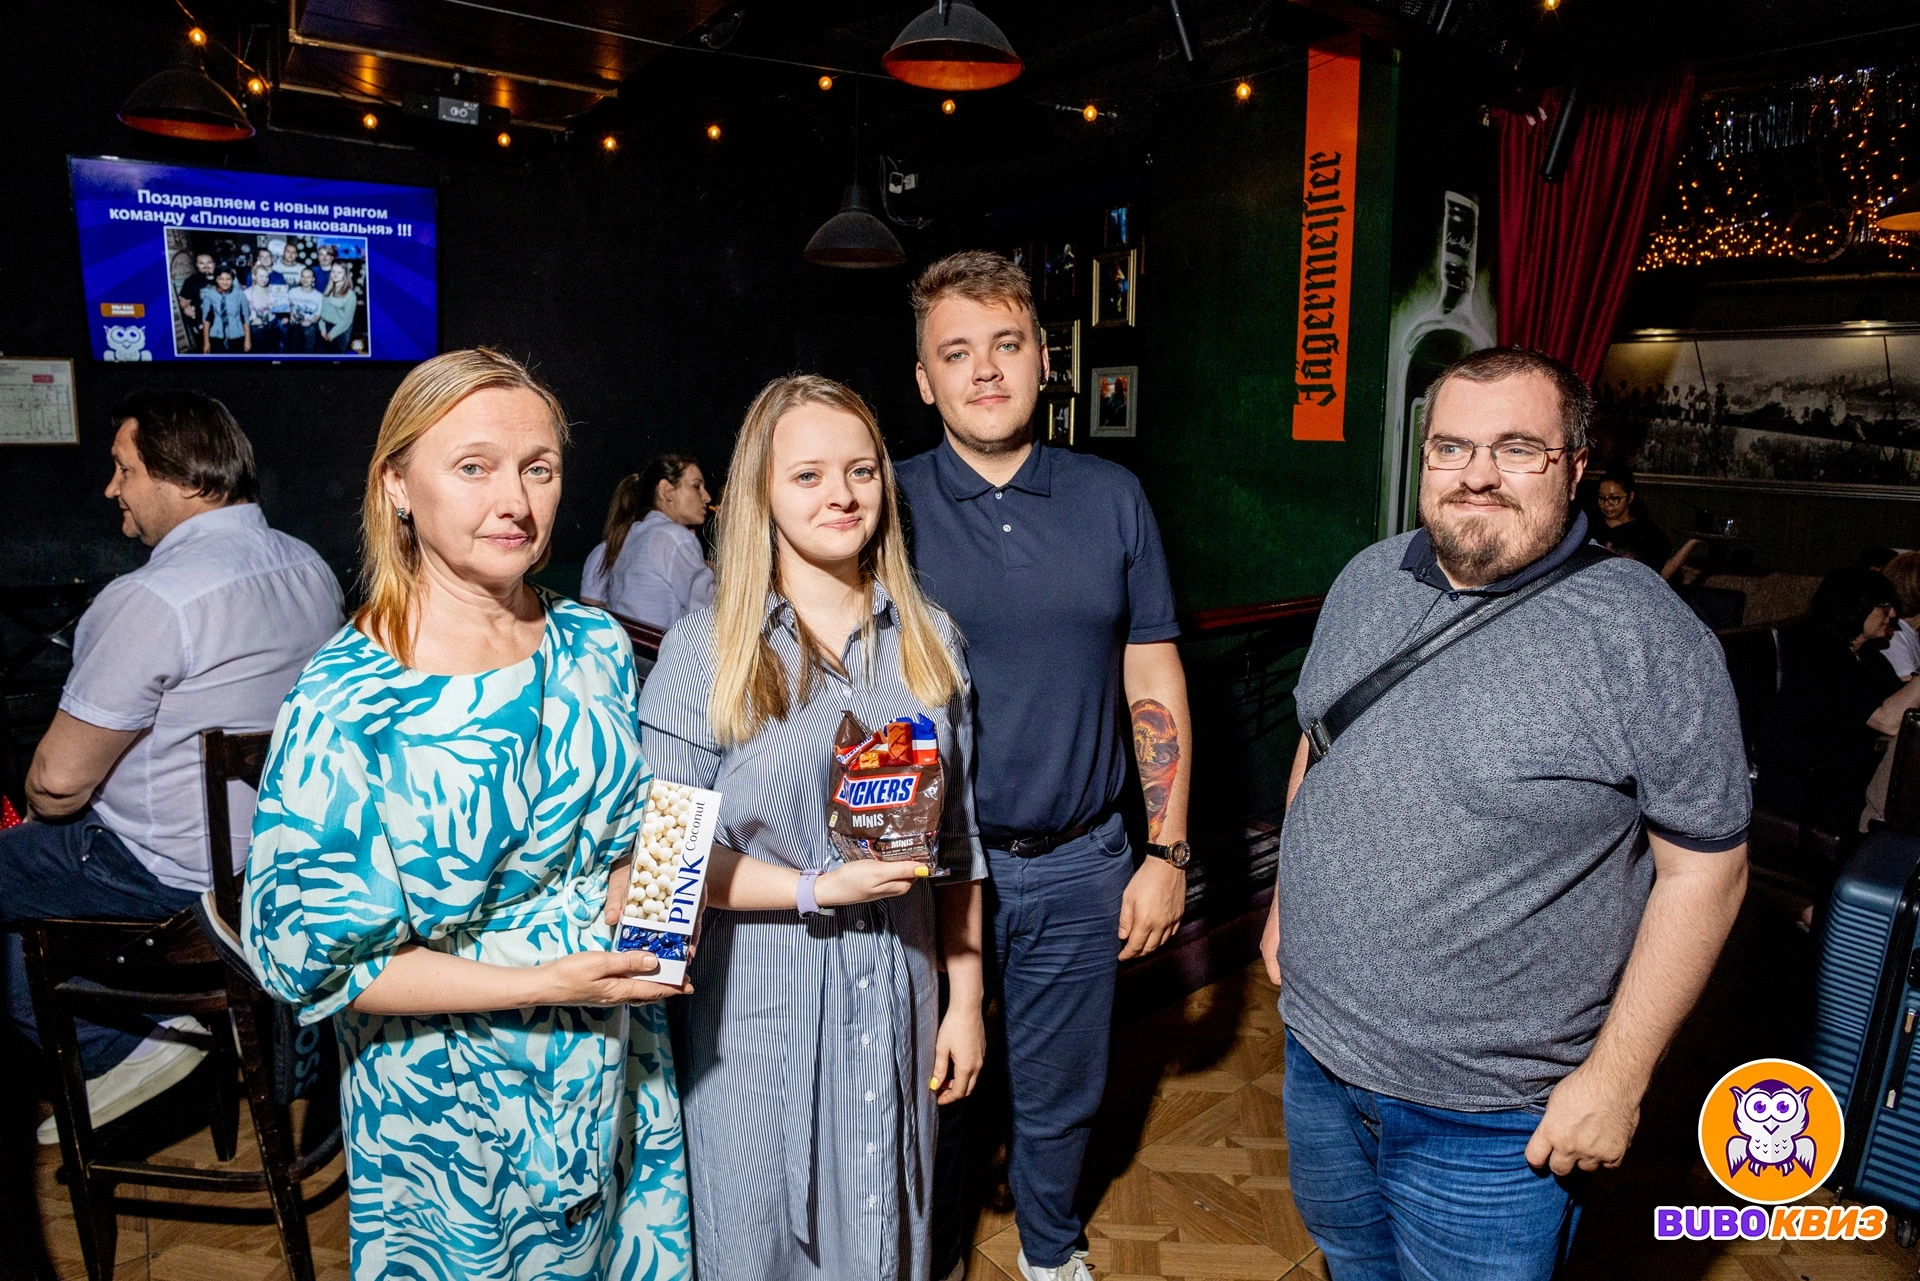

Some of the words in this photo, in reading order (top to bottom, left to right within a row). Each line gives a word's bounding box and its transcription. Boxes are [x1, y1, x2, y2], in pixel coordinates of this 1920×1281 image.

[137, 189, 256, 211] Поздравляем
[260, 201, 270, 211] с
[274, 202, 329, 216] новым
[333, 206, 388, 220] рангом
[109, 207, 185, 226] команду
[190, 211, 290, 229] «Плюшевая
[293, 220, 393, 236] наковальня»
[397, 224, 412, 237] !!!
[685, 801, 706, 851] Coconut
[852, 813, 885, 829] MINIS
[891, 838, 914, 849] MINIS
[668, 853, 705, 925] PINK
[294, 1024, 320, 1097] OSS
